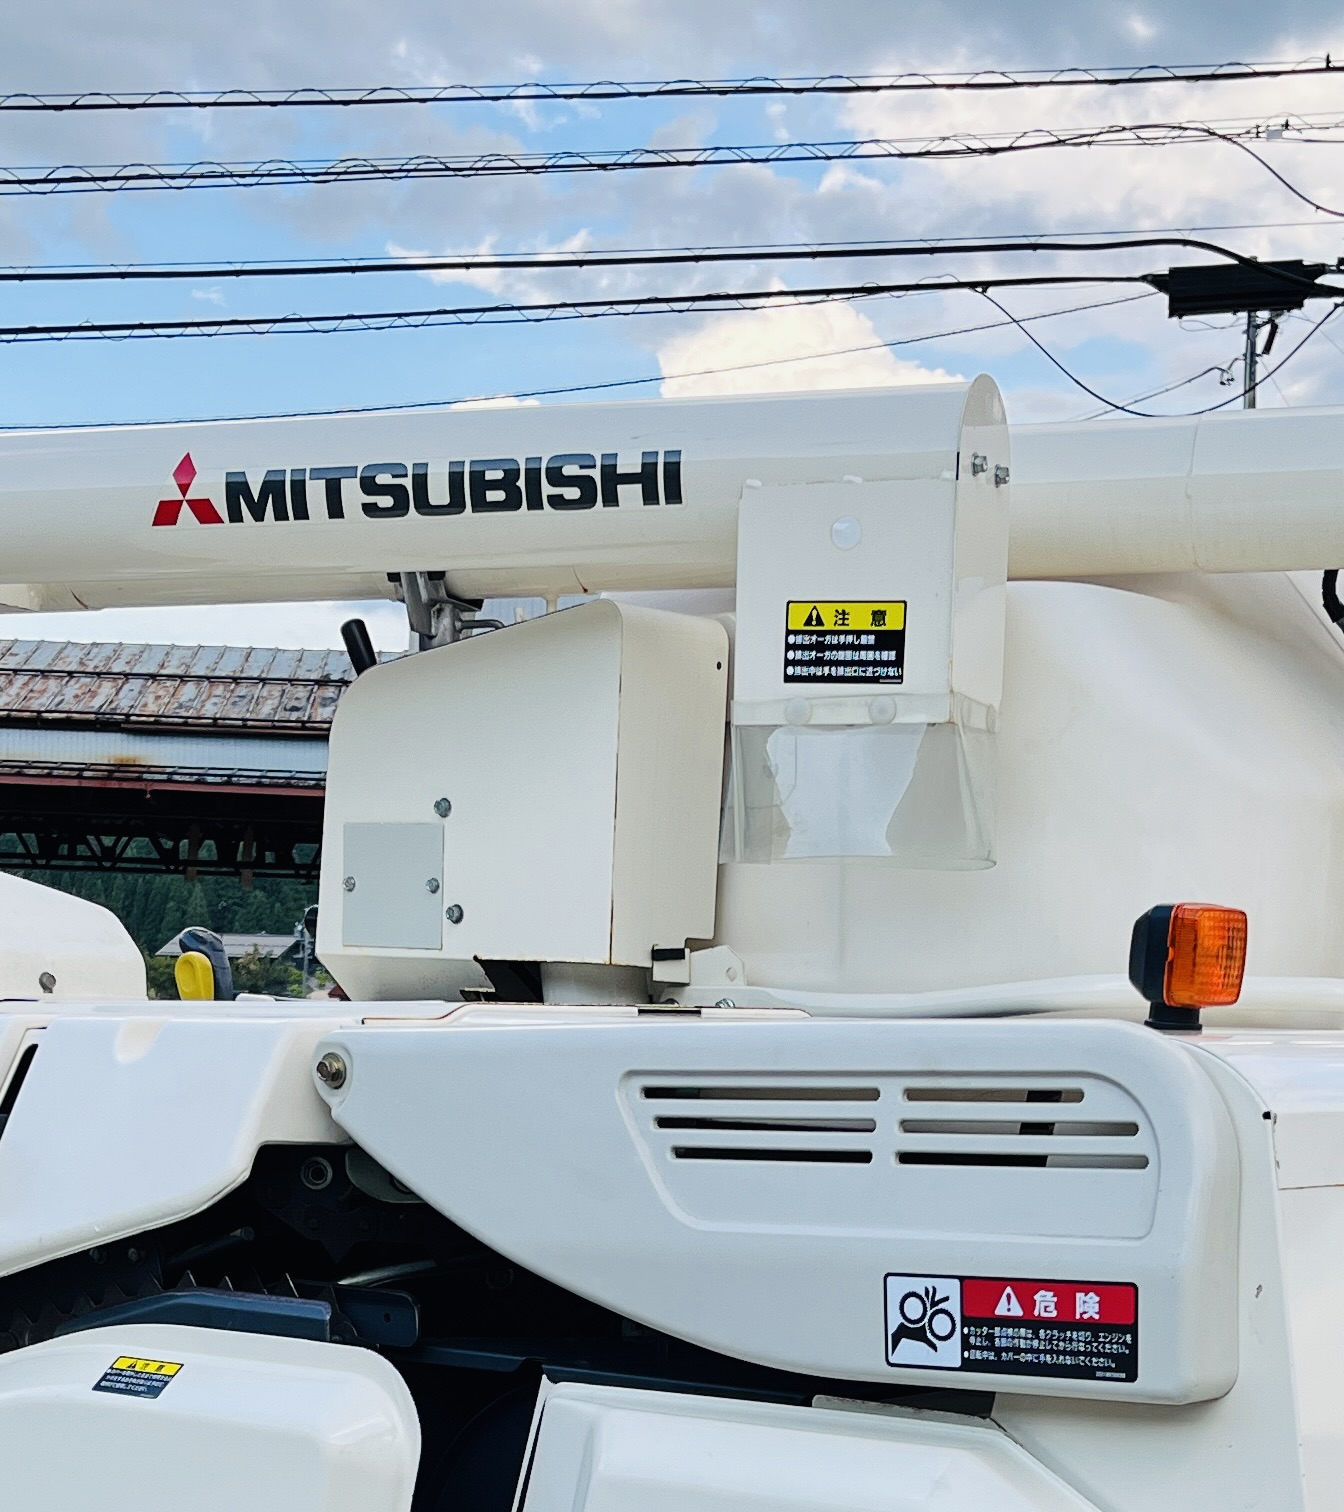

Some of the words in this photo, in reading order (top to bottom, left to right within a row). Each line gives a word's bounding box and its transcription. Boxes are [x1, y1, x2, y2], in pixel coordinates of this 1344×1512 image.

[225, 449, 684, 524] MITSUBISHI
[833, 608, 888, 628] 注意
[1033, 1289, 1101, 1321] 危険
